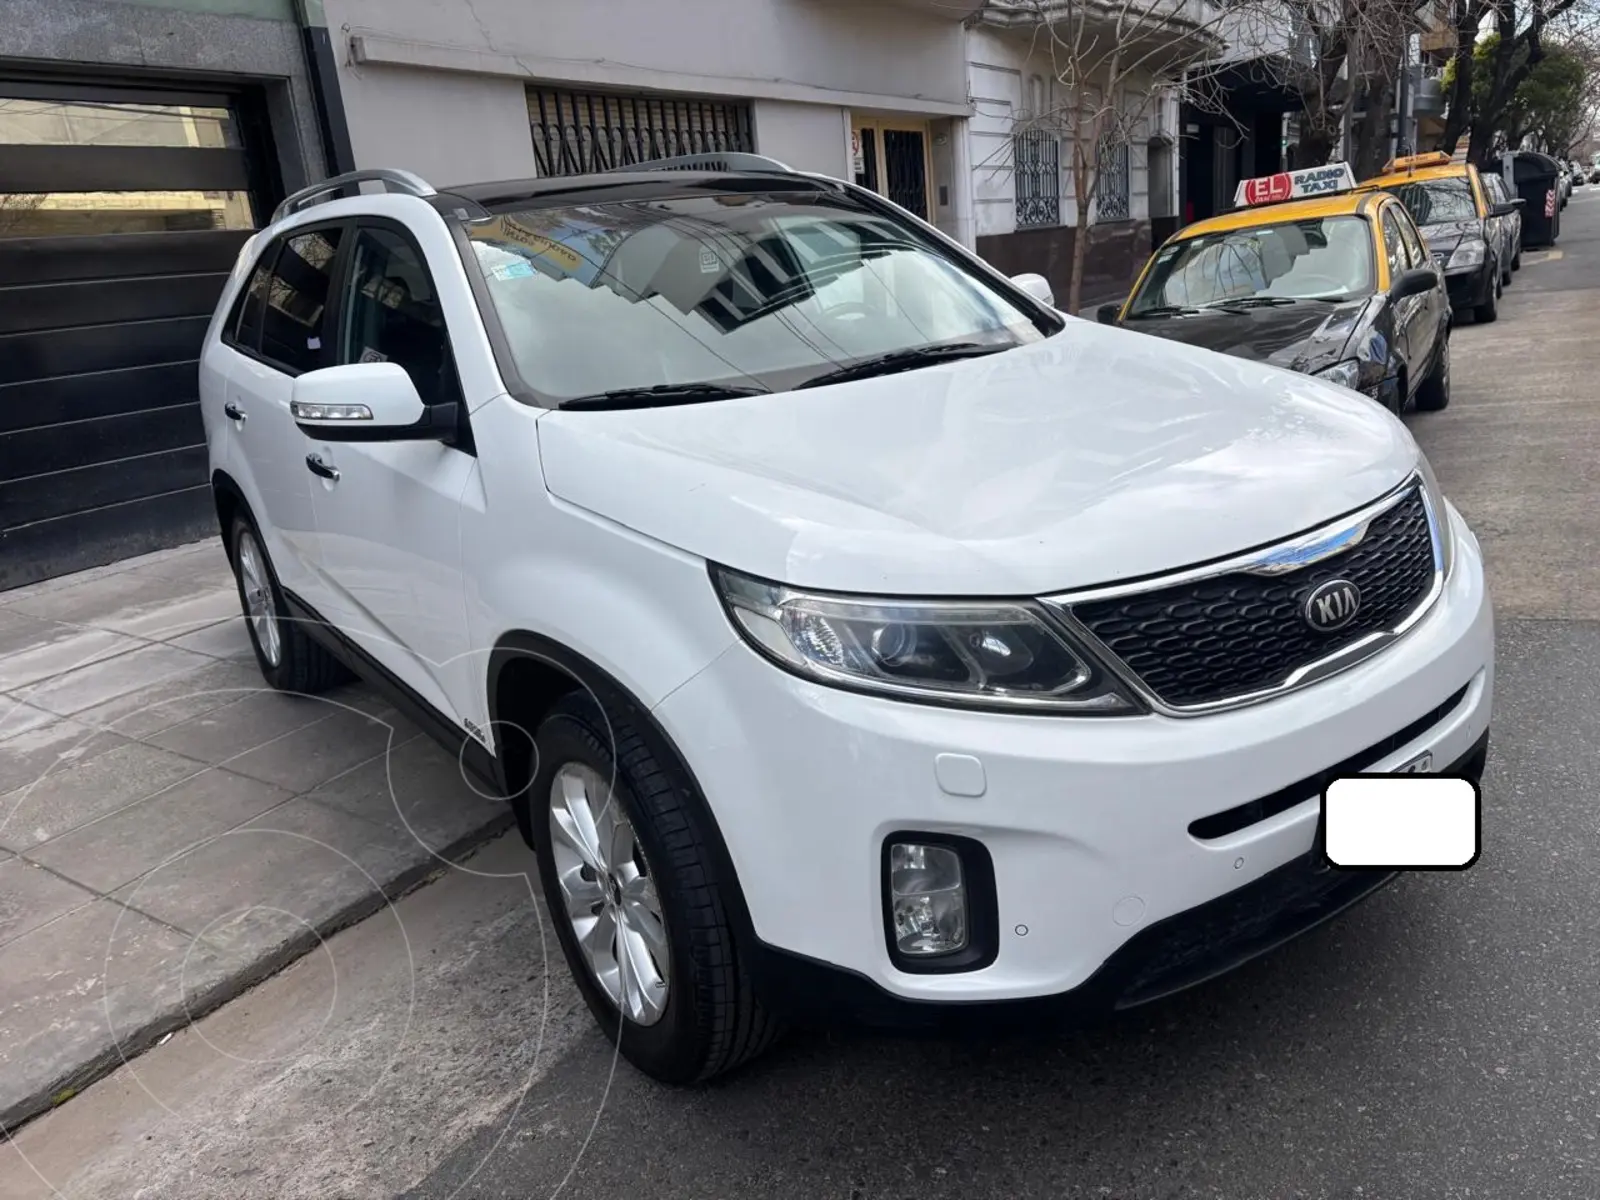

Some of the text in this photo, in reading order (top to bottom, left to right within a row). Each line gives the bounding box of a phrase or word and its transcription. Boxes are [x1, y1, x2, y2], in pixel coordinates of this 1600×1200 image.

[1294, 168, 1345, 185] RADIO
[1255, 178, 1283, 196] EL
[1300, 179, 1338, 194] TAXI
[1316, 587, 1357, 624] KIA
